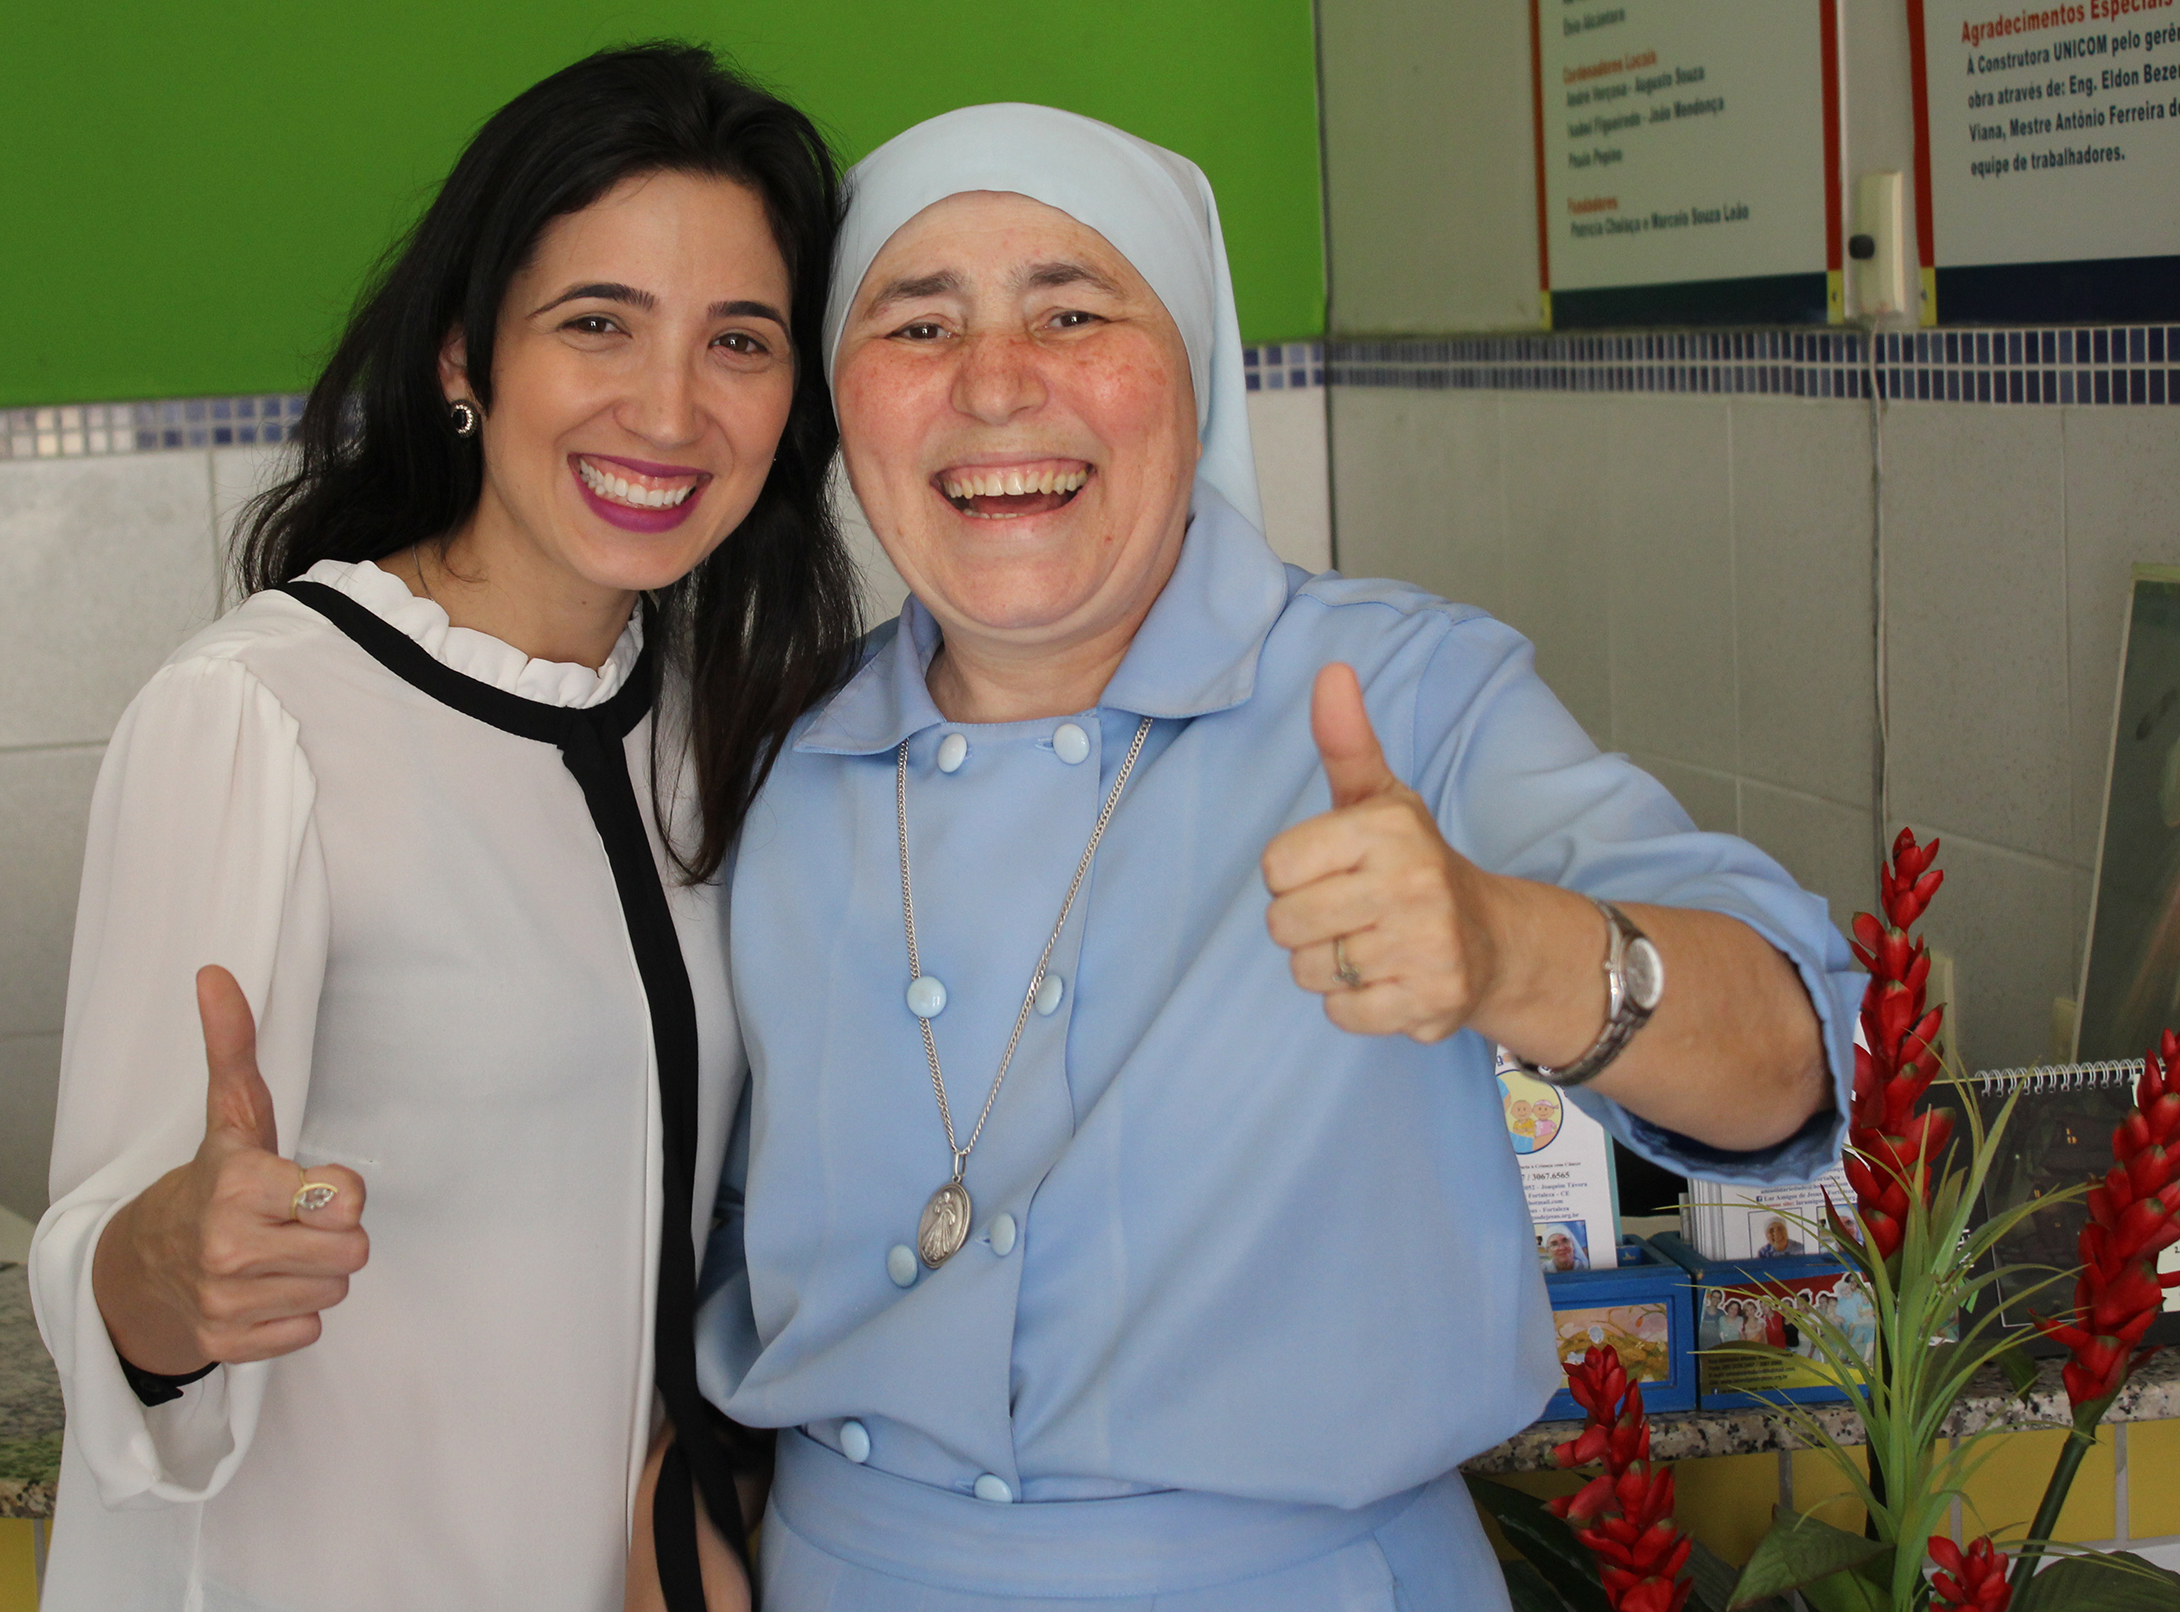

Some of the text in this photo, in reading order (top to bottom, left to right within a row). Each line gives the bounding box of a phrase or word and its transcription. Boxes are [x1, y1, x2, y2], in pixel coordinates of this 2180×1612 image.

[1962, 4, 2084, 47] Agradecimentos
[1978, 48, 2050, 73] Construtora
[2054, 34, 2107, 61] UNICOM
[2112, 30, 2140, 57] pelo
[1968, 90, 1994, 109] obra
[1998, 82, 2042, 105] através
[2046, 78, 2066, 98] de:
[2069, 74, 2097, 97] Eng.
[2102, 68, 2139, 89] Eldon
[1969, 123, 2006, 142] Viana,
[2009, 117, 2051, 137] Mestre
[2109, 100, 2165, 125] Ferreira
[1971, 144, 2125, 179] equipe de trabalhadores.
[1691, 206, 1721, 226] Souza
[1532, 1171, 1570, 1182] 3067.6565
[1541, 1182, 1565, 1191] Joaquim
[1528, 1192, 1555, 1200] Fortaleza
[1561, 1190, 1569, 1198] CE
[1776, 1193, 1796, 1203] Amigos
[1542, 1205, 1569, 1213] Fortaleza
